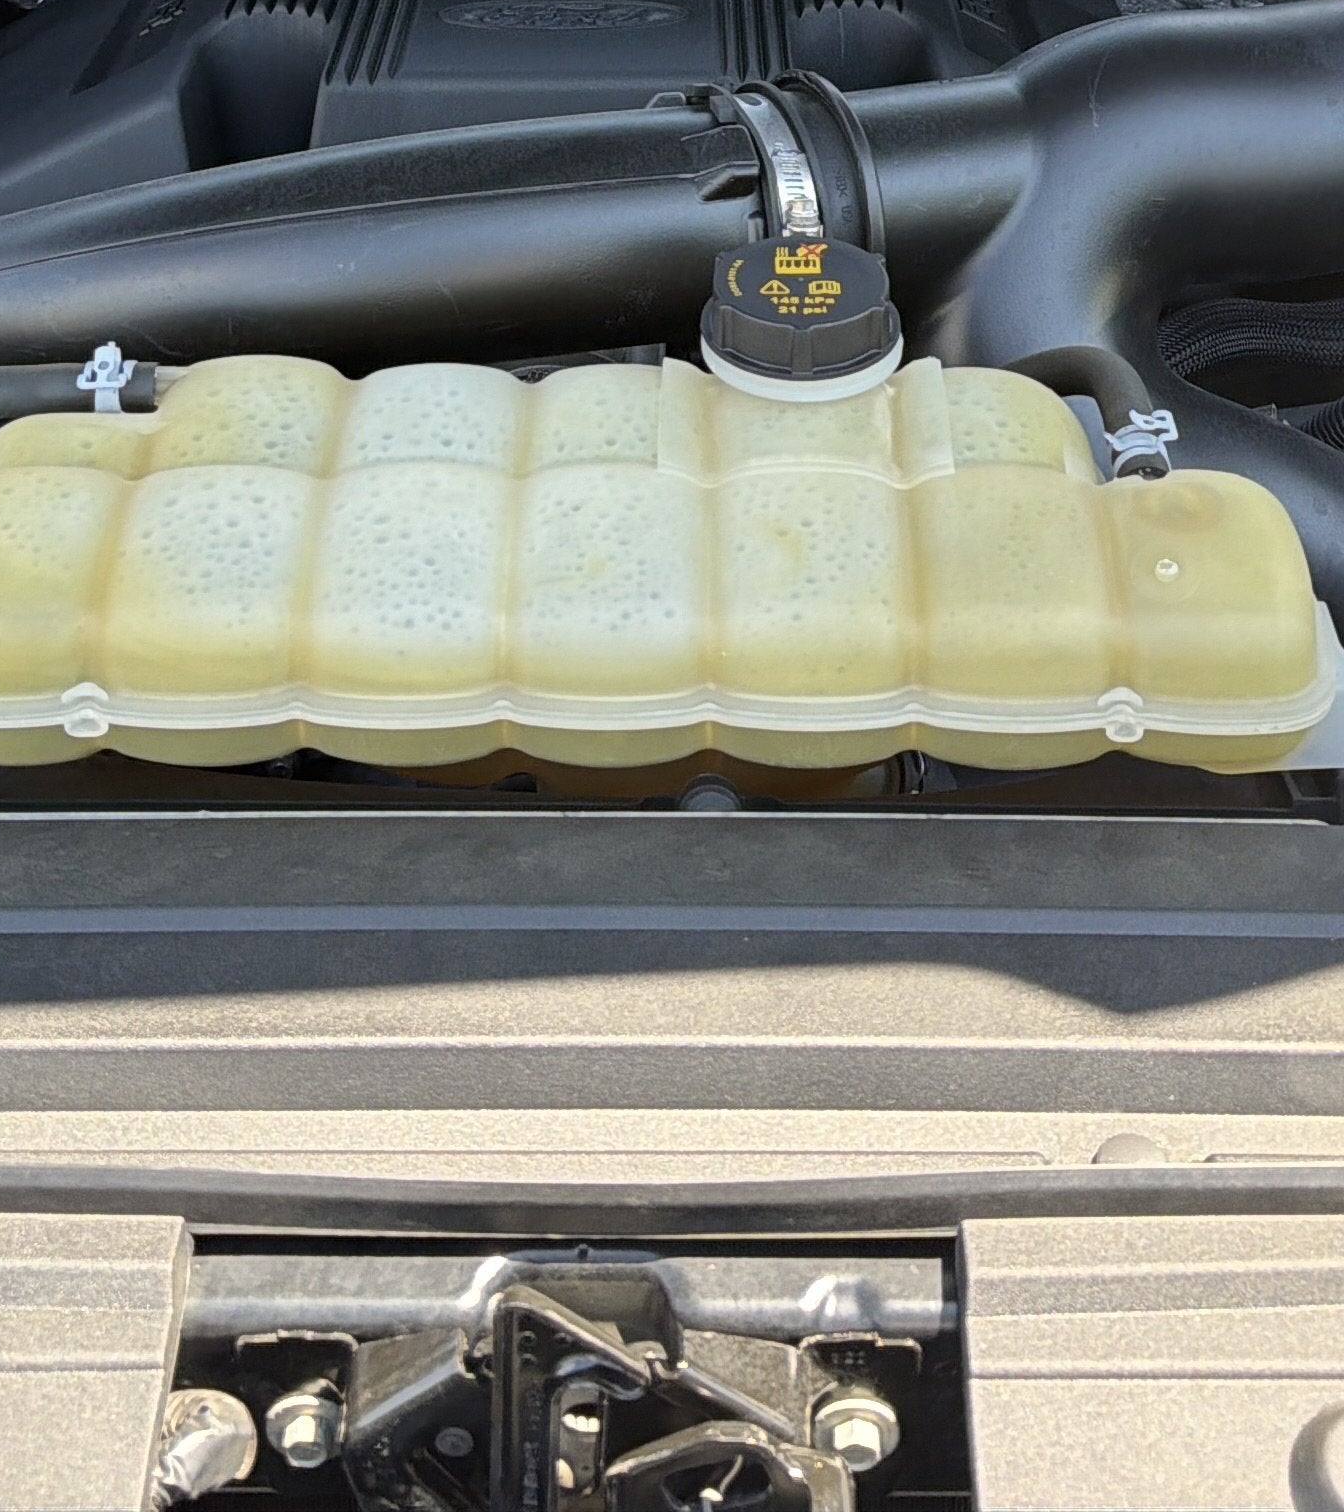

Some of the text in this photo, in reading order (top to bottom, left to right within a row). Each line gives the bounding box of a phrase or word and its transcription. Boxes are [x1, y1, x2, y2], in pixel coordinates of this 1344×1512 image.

[770, 296, 835, 305] 145 kPa
[778, 306, 828, 315] 21 psi
